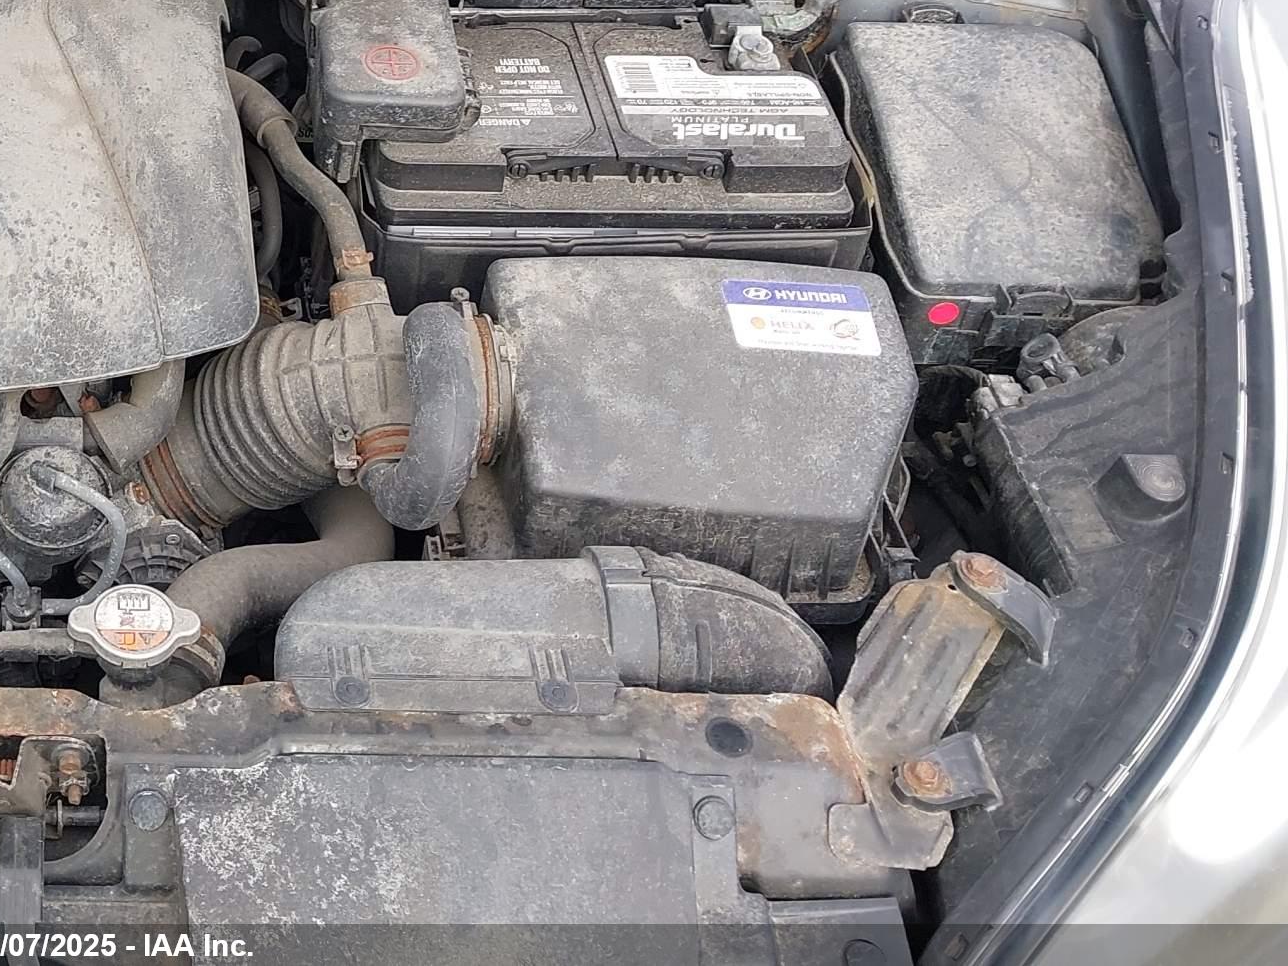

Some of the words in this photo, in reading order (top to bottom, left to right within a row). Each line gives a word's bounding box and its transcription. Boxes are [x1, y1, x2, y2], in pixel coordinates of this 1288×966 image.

[494, 65, 518, 73] OPEN
[519, 65, 537, 73] NOT
[537, 65, 551, 73] DO
[672, 123, 805, 141] Duralast
[775, 289, 848, 304] HYUNDAI
